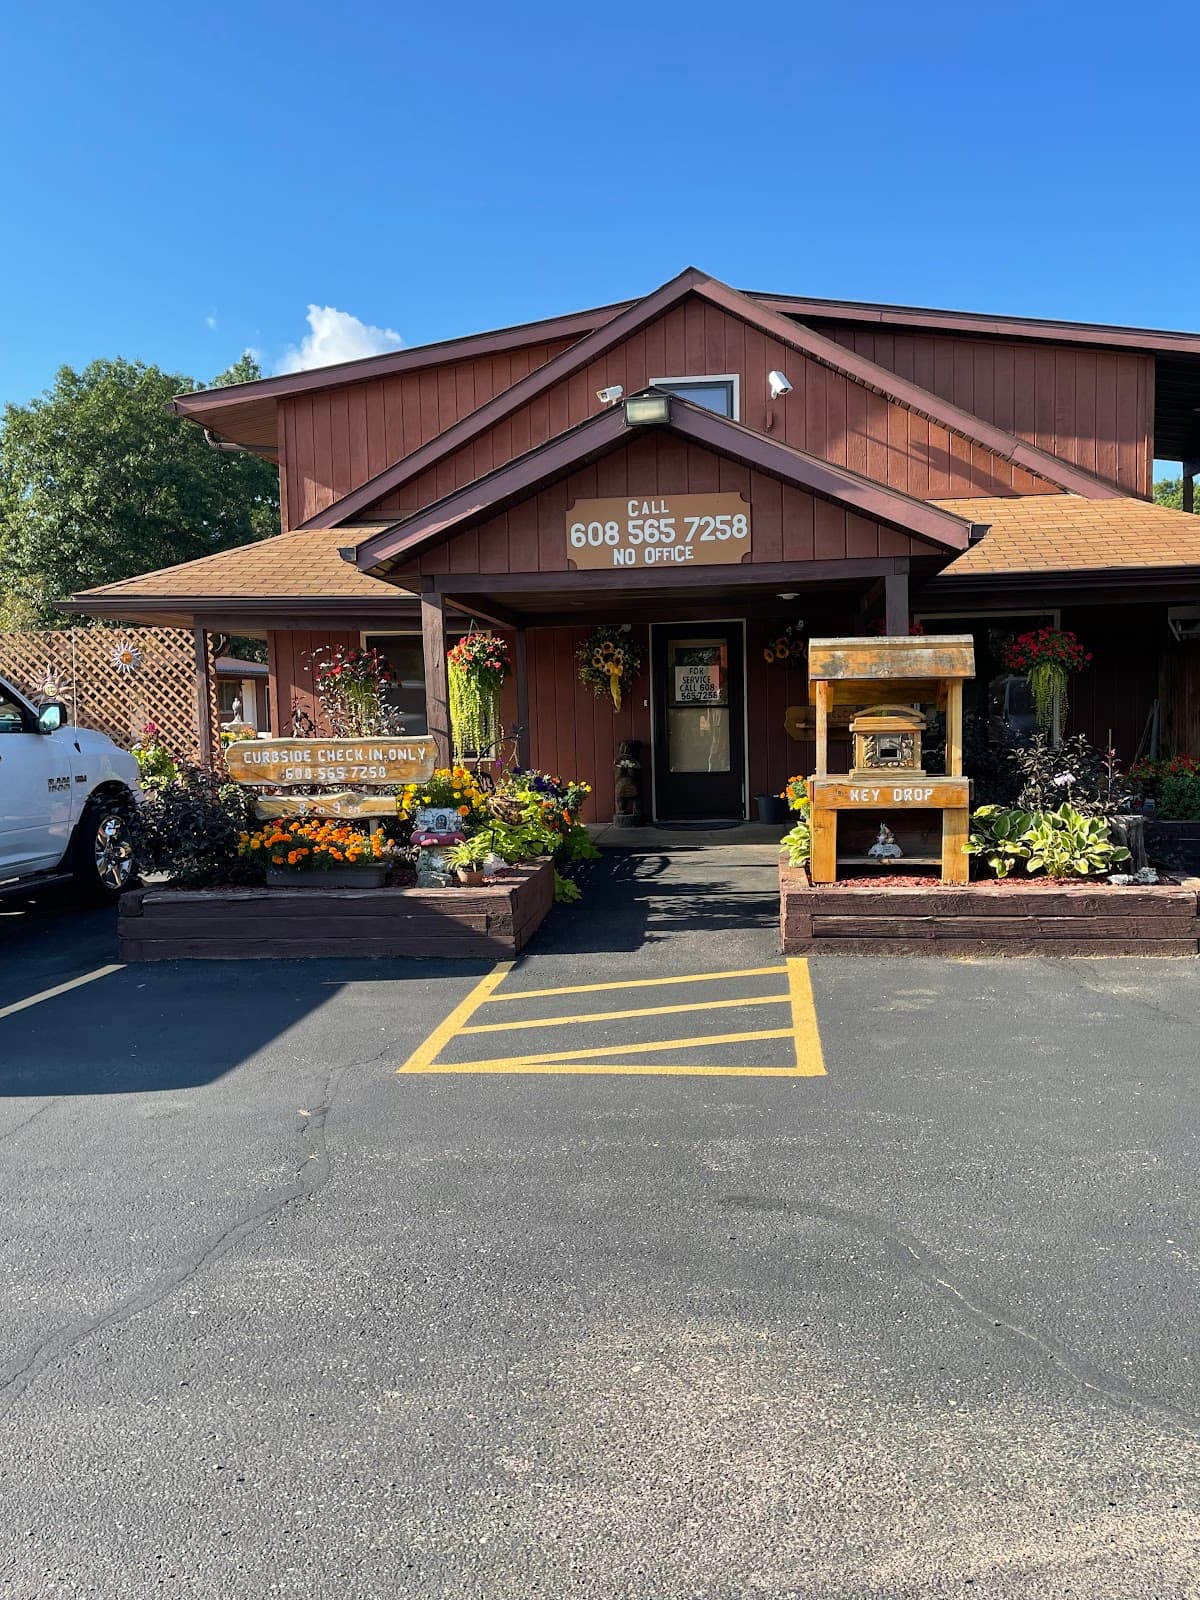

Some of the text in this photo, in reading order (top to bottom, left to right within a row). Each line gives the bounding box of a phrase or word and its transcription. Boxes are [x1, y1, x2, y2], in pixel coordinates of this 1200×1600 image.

[627, 500, 670, 517] CALL
[570, 513, 748, 548] 608 565 7258
[613, 545, 694, 566] NO OFFICE
[689, 667, 704, 675] FOR
[682, 675, 711, 684] SERVICE
[680, 683, 715, 692] CALL 608
[243, 749, 312, 764] CURBSIDE
[388, 747, 426, 761] ONLY
[850, 788, 934, 801] KEY DROP
